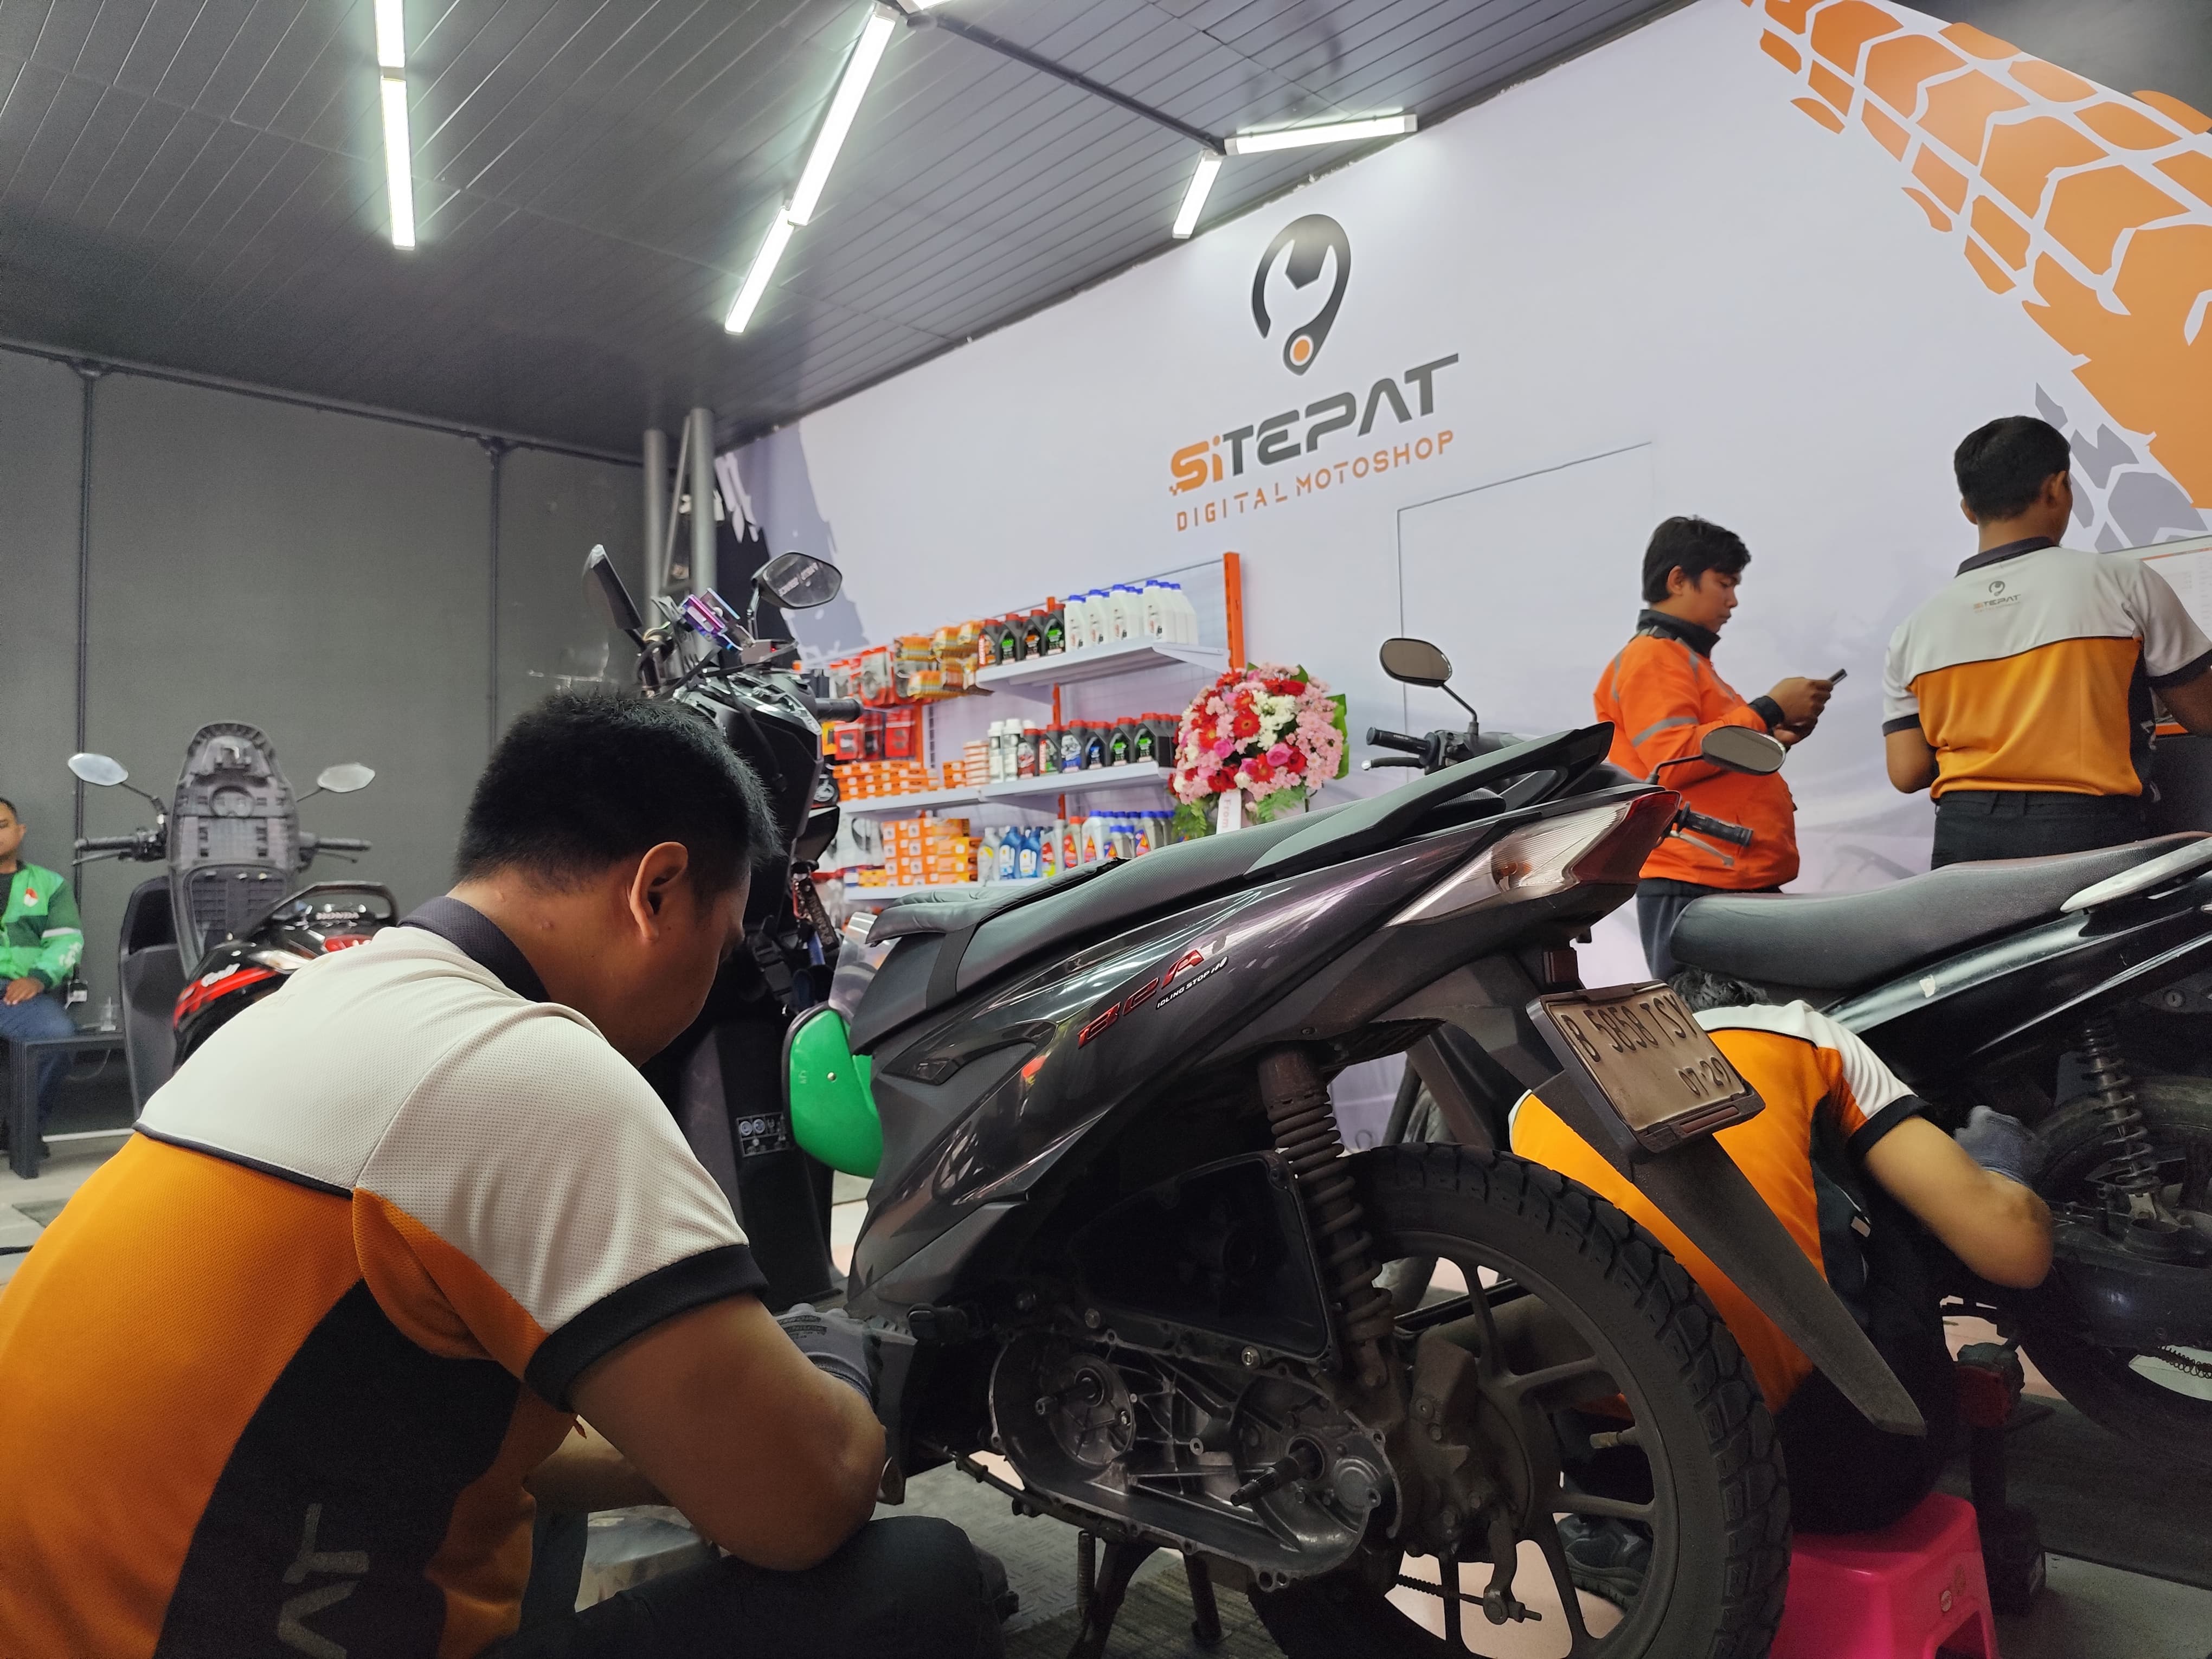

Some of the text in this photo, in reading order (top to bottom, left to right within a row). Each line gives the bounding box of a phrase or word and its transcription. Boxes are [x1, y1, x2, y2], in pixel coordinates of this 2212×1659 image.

[1176, 430, 1453, 532] DIGITAL MOTOSHOP
[1157, 970, 1210, 1008] IDLING STOP
[1560, 994, 1698, 1063] B 5858 TSY
